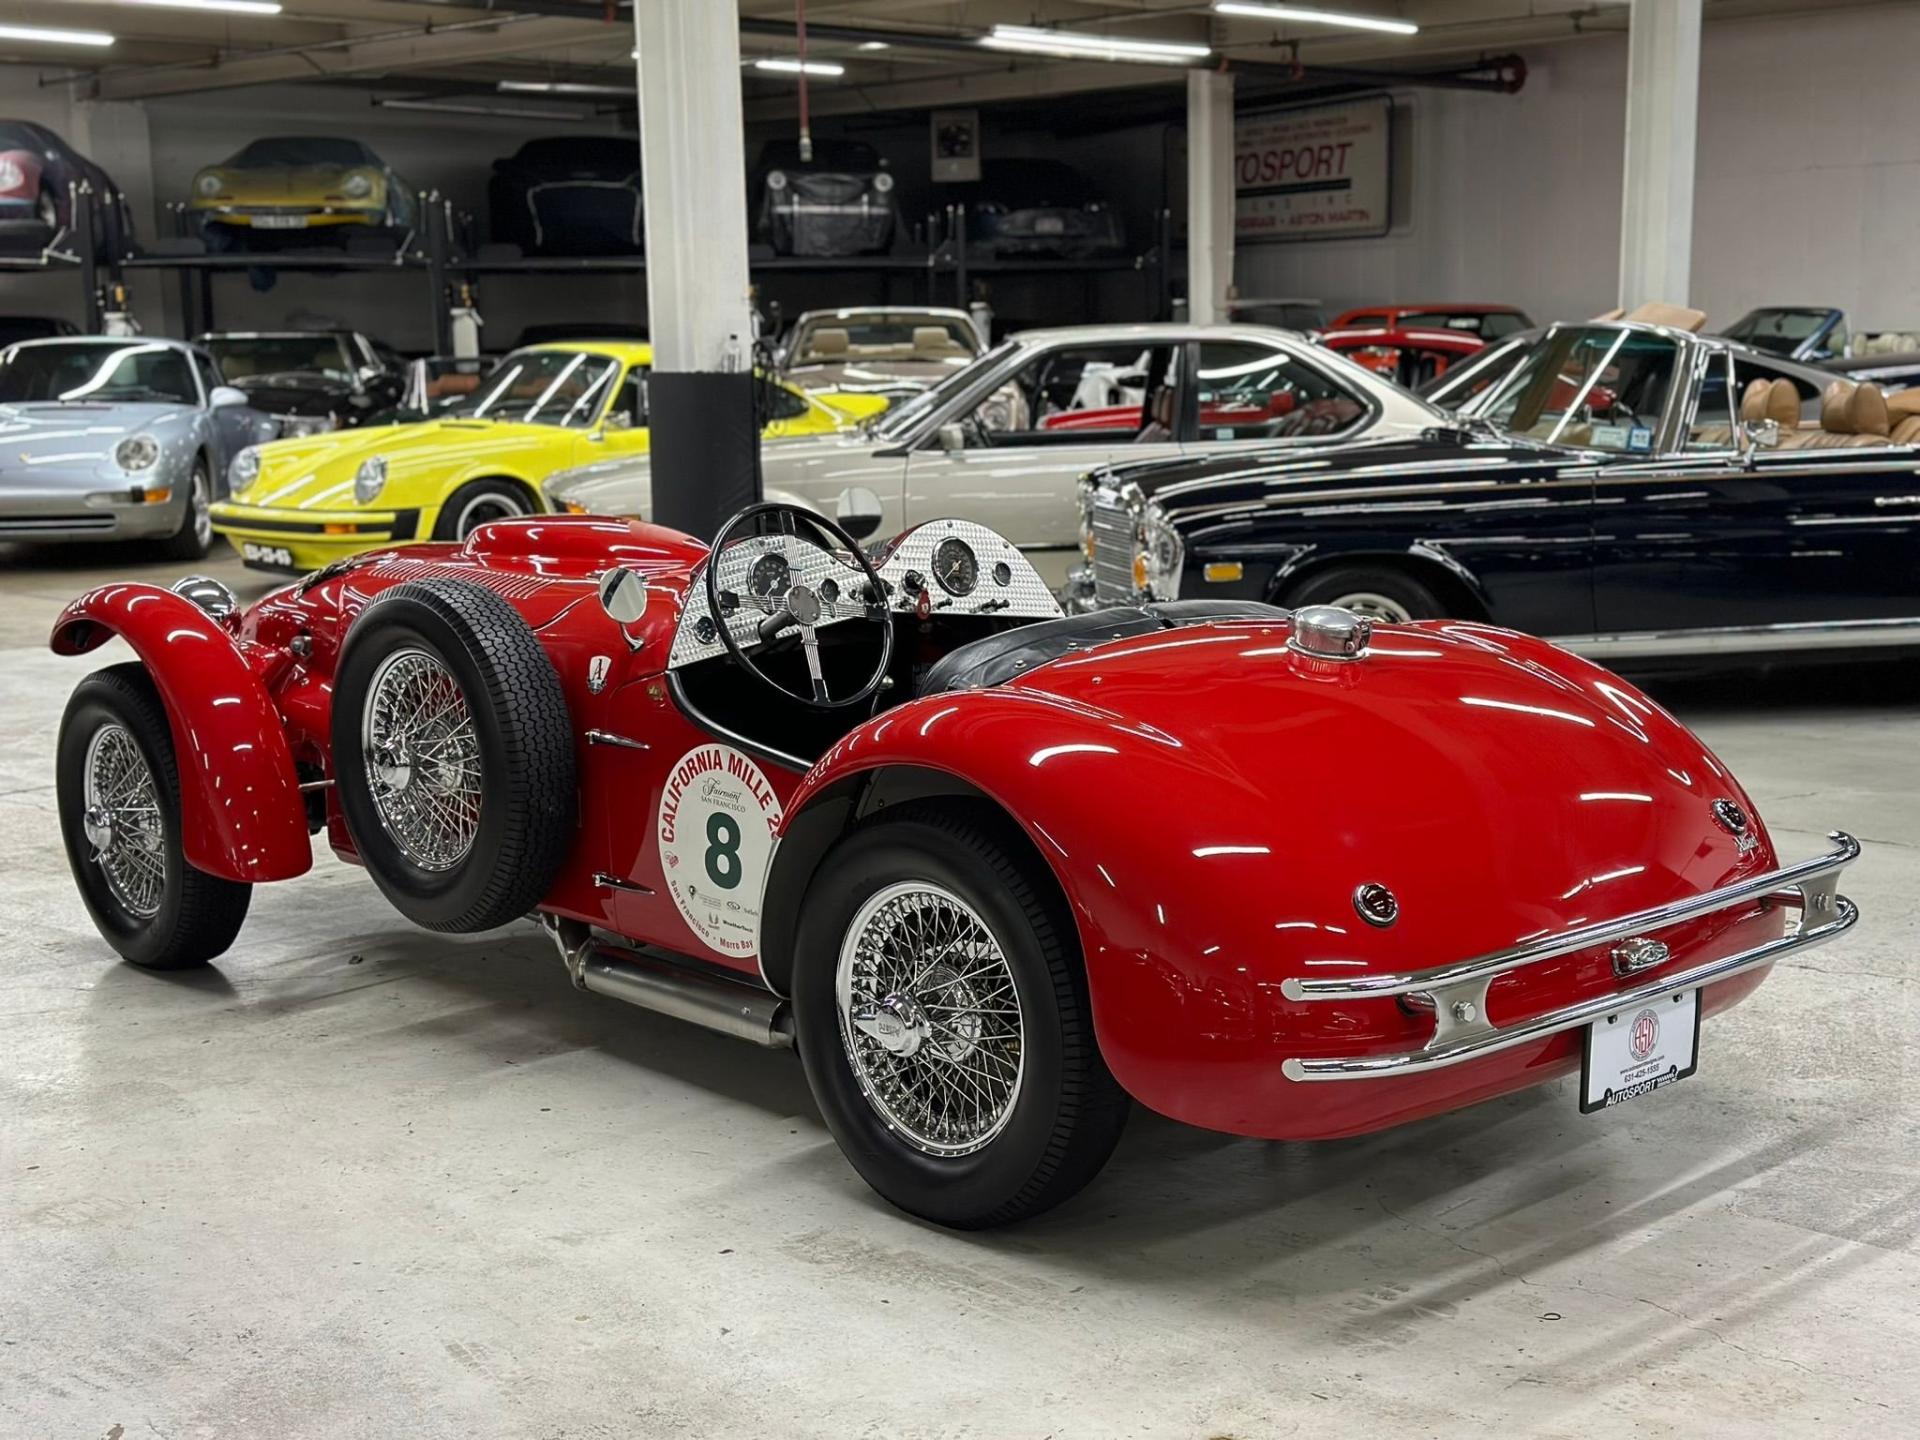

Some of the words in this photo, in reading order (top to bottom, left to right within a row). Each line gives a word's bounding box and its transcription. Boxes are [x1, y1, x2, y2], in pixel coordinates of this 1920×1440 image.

[662, 750, 723, 843] CALIFORNIA
[727, 752, 773, 811] MILLE
[702, 777, 742, 803] Fairmont
[713, 799, 746, 813] FRANCISCO
[705, 812, 742, 889] 8
[670, 880, 681, 900] San
[680, 899, 710, 938] Francisco
[720, 937, 740, 950] Morro
[740, 939, 754, 950] Bay
[1606, 1080, 1656, 1106] AUTOSPORT
